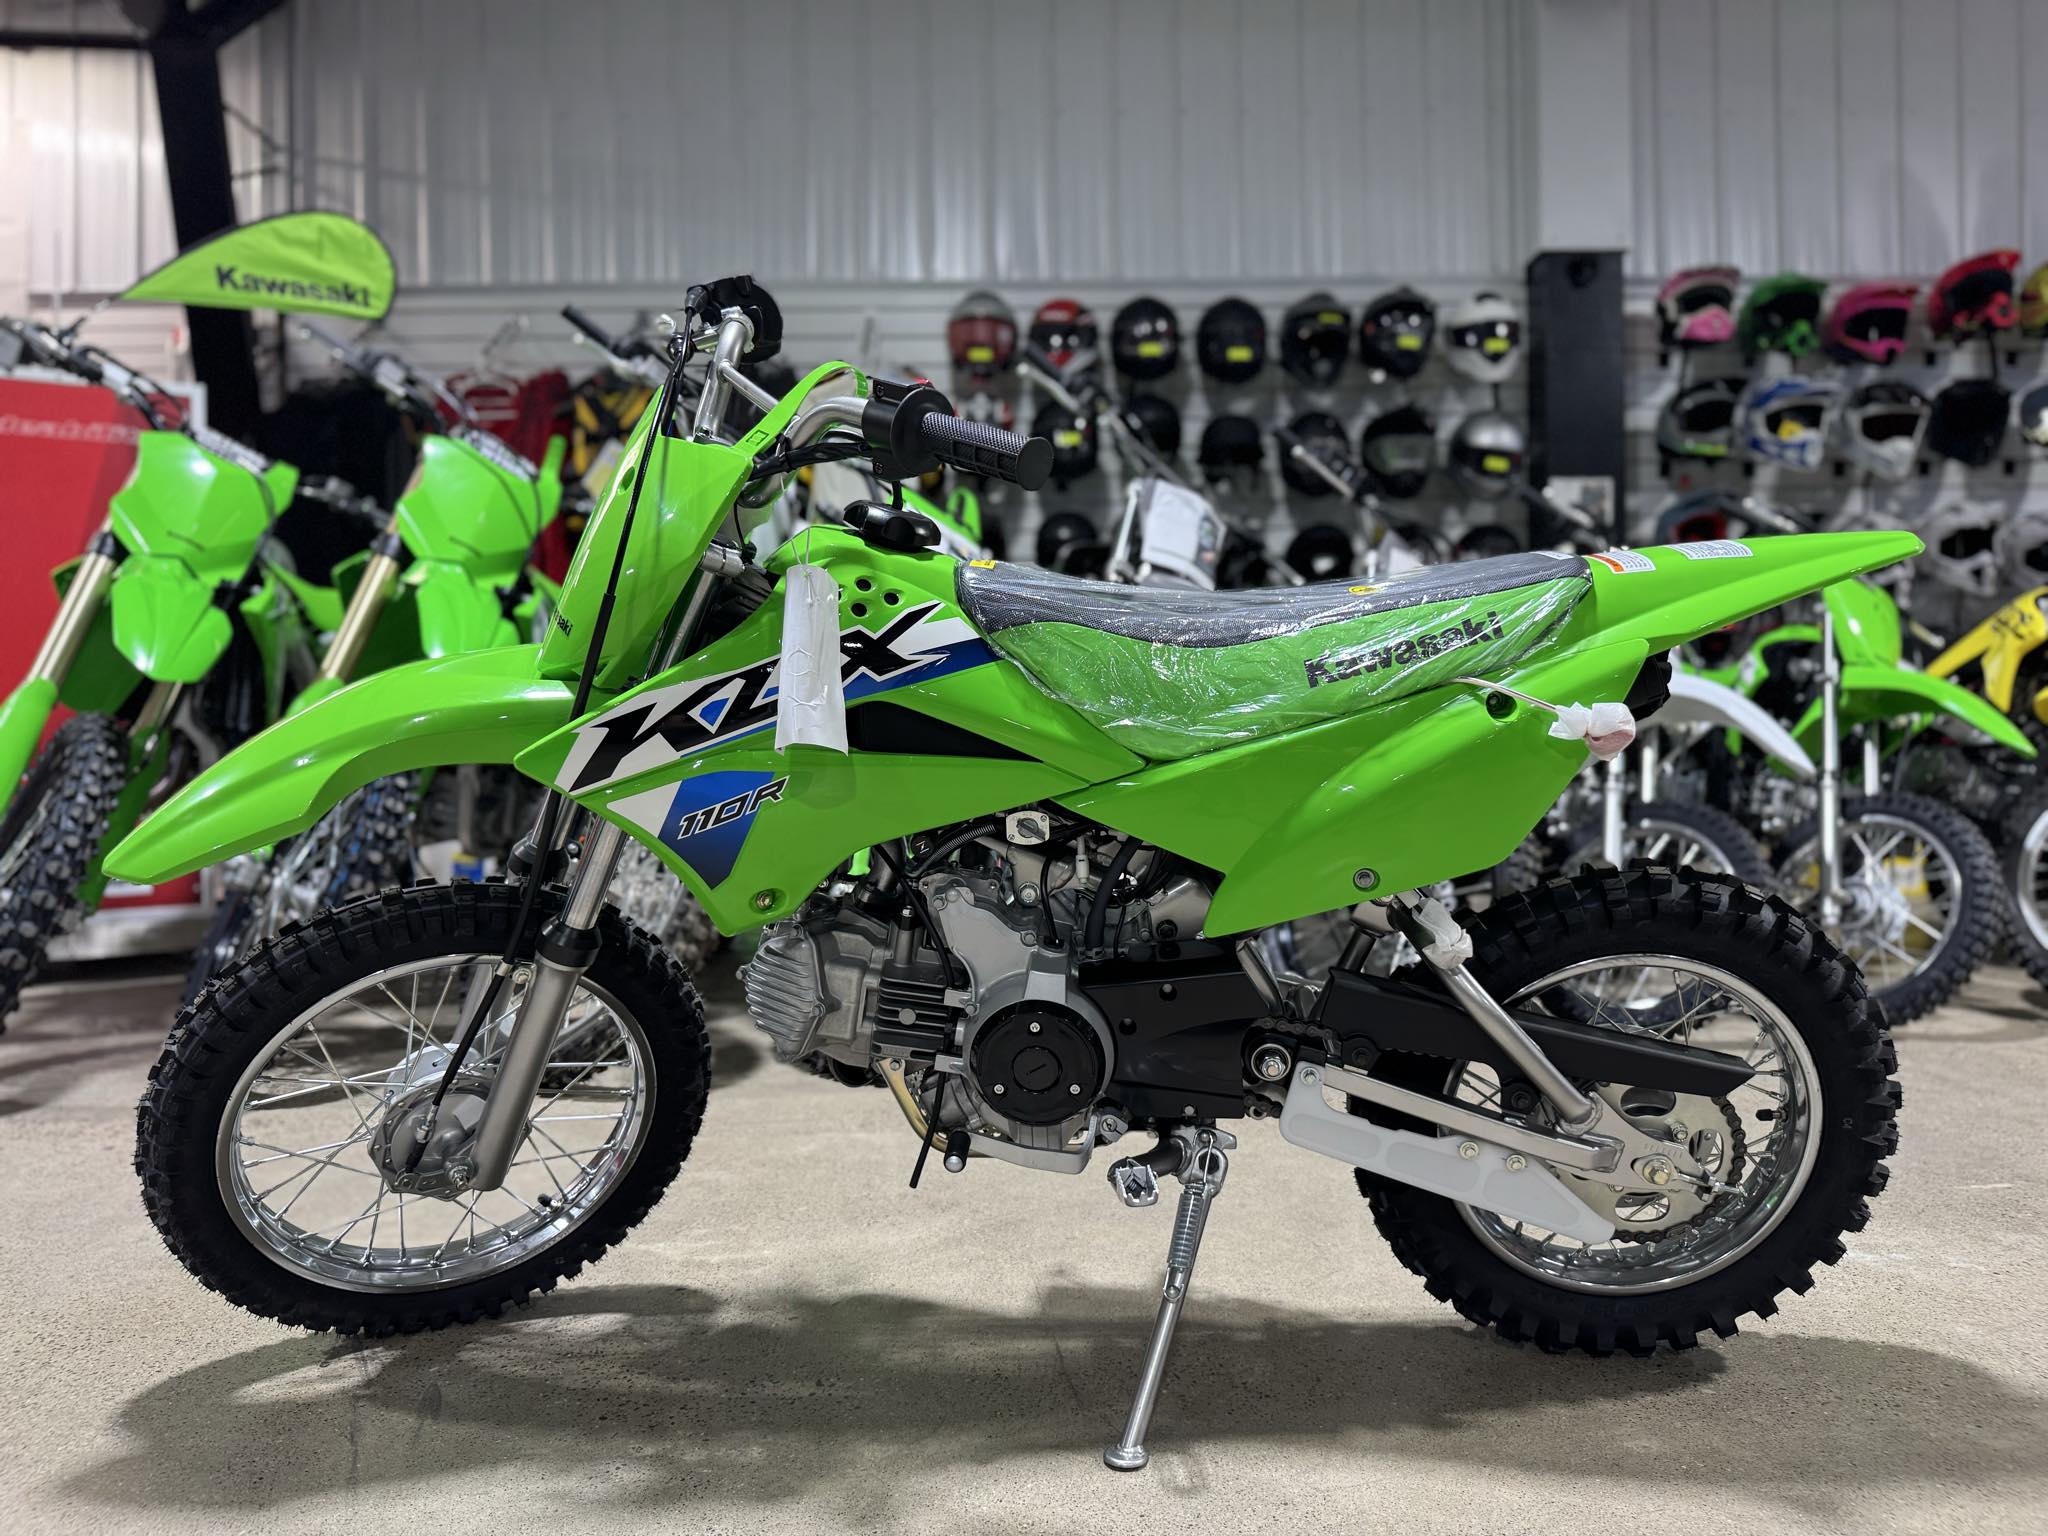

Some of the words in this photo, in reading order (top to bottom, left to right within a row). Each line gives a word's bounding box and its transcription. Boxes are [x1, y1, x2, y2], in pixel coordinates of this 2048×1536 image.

[215, 264, 372, 308] Kawasaki
[1304, 611, 1504, 688] Kawasaki
[678, 776, 789, 839] 110R
